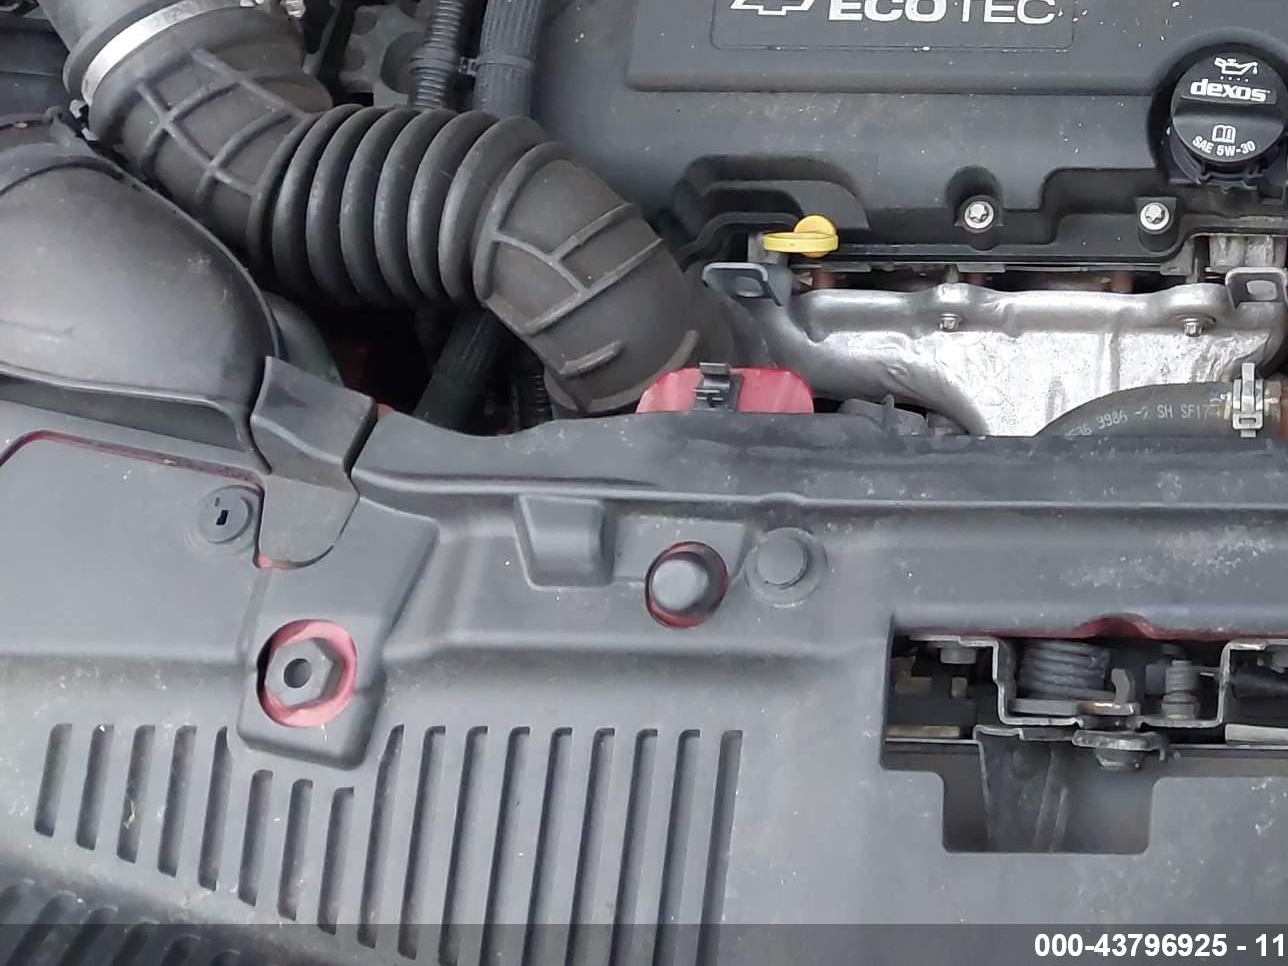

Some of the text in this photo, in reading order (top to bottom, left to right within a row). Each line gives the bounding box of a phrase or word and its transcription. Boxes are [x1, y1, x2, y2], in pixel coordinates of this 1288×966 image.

[1190, 79, 1271, 101] dexos
[1192, 136, 1256, 156] SAE 5W-30
[1096, 410, 1128, 430] 3986
[1157, 404, 1174, 419] SH
